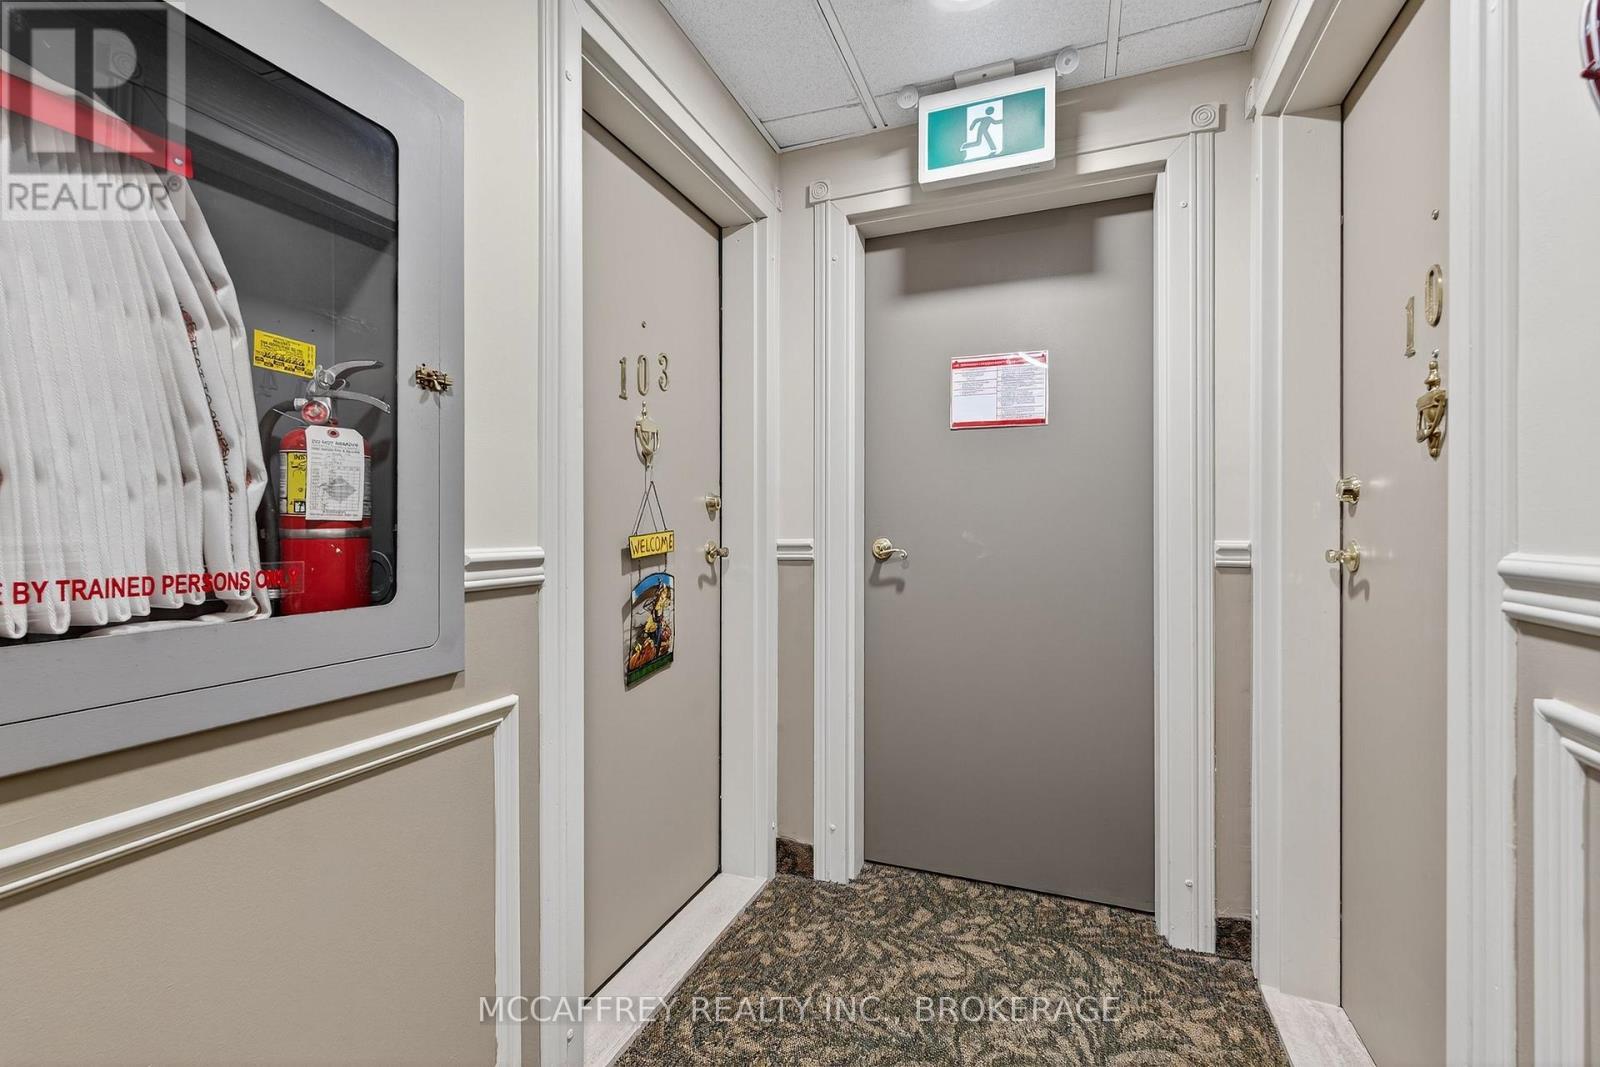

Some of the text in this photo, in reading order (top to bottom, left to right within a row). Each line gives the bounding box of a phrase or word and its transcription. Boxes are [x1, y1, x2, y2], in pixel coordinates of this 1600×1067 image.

[619, 353, 669, 400] 103
[631, 534, 673, 555] WELCOME
[13, 580, 49, 605] BY
[55, 576, 155, 602] TRAINED
[162, 571, 251, 595] PERSONS
